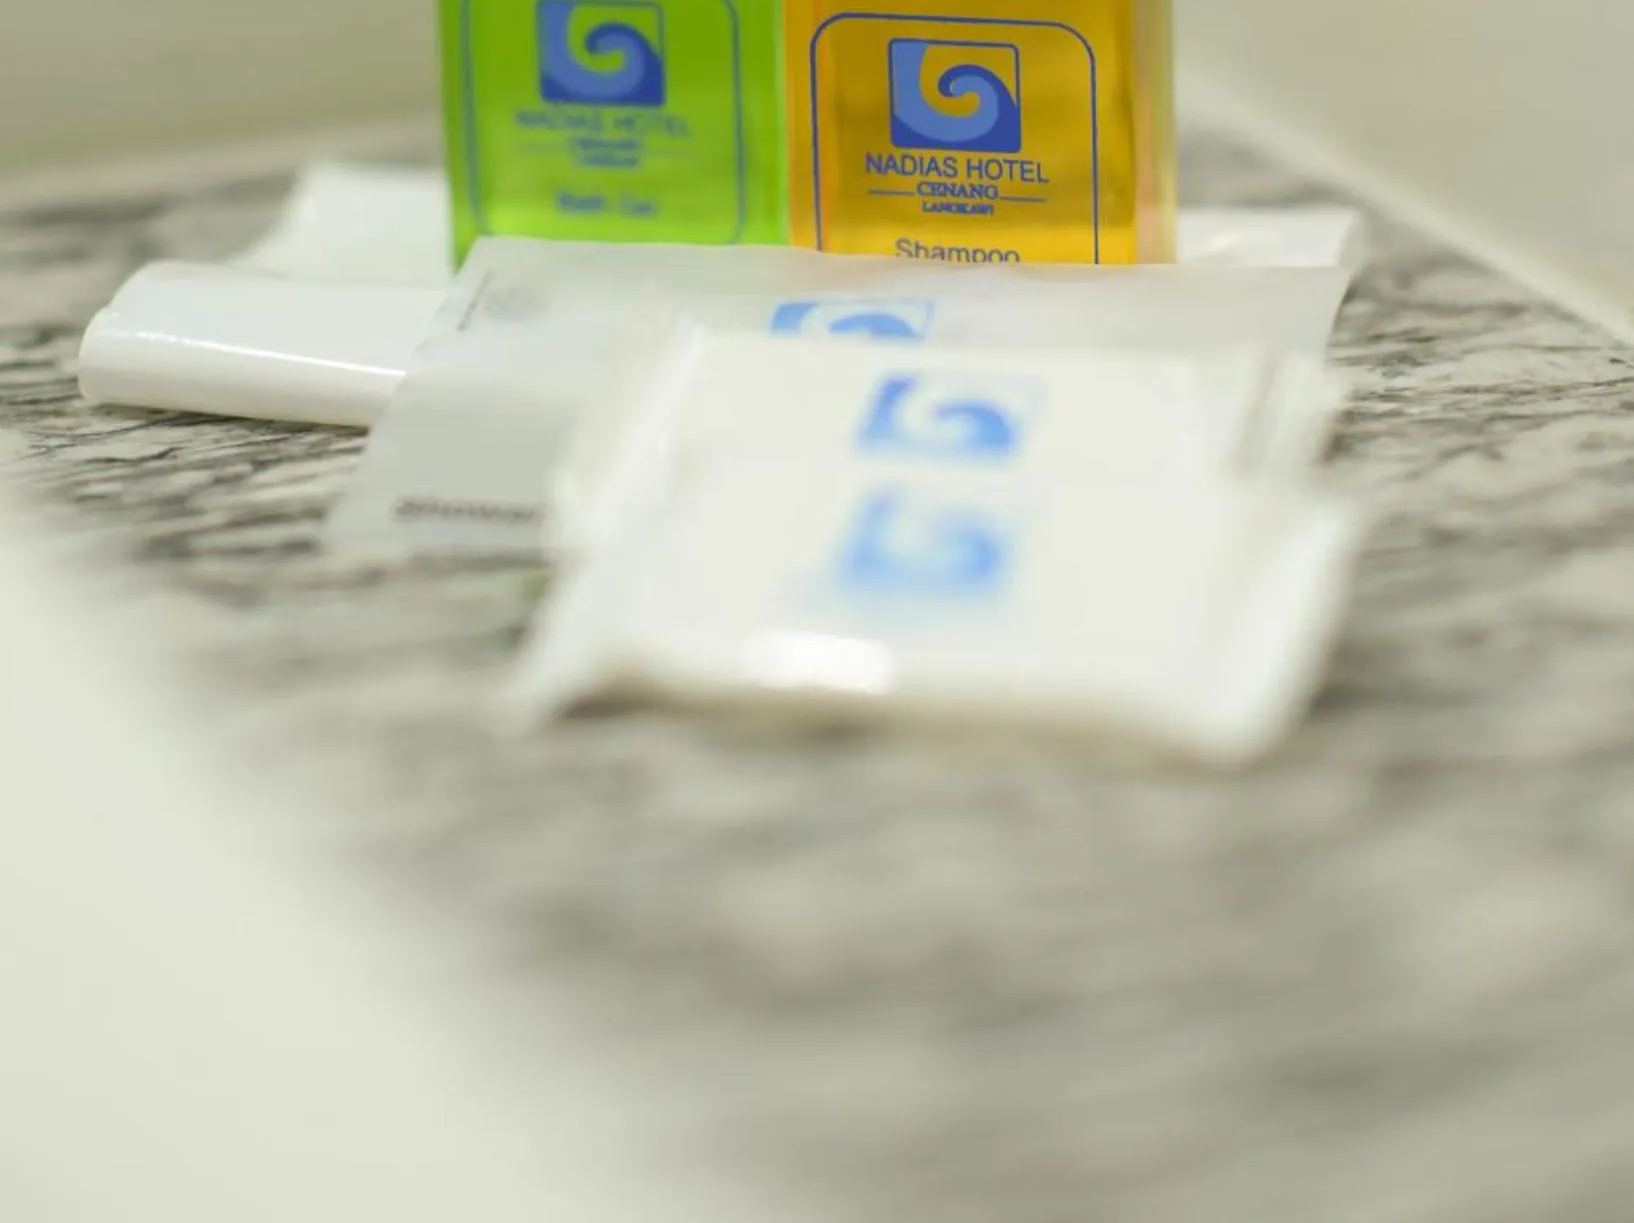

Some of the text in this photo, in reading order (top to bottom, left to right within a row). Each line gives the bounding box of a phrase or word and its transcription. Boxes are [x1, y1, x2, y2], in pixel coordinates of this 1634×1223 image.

[865, 152, 1049, 183] NADIAS HOTEL
[917, 180, 999, 200] CENANG
[894, 237, 1021, 263] Shampoo
